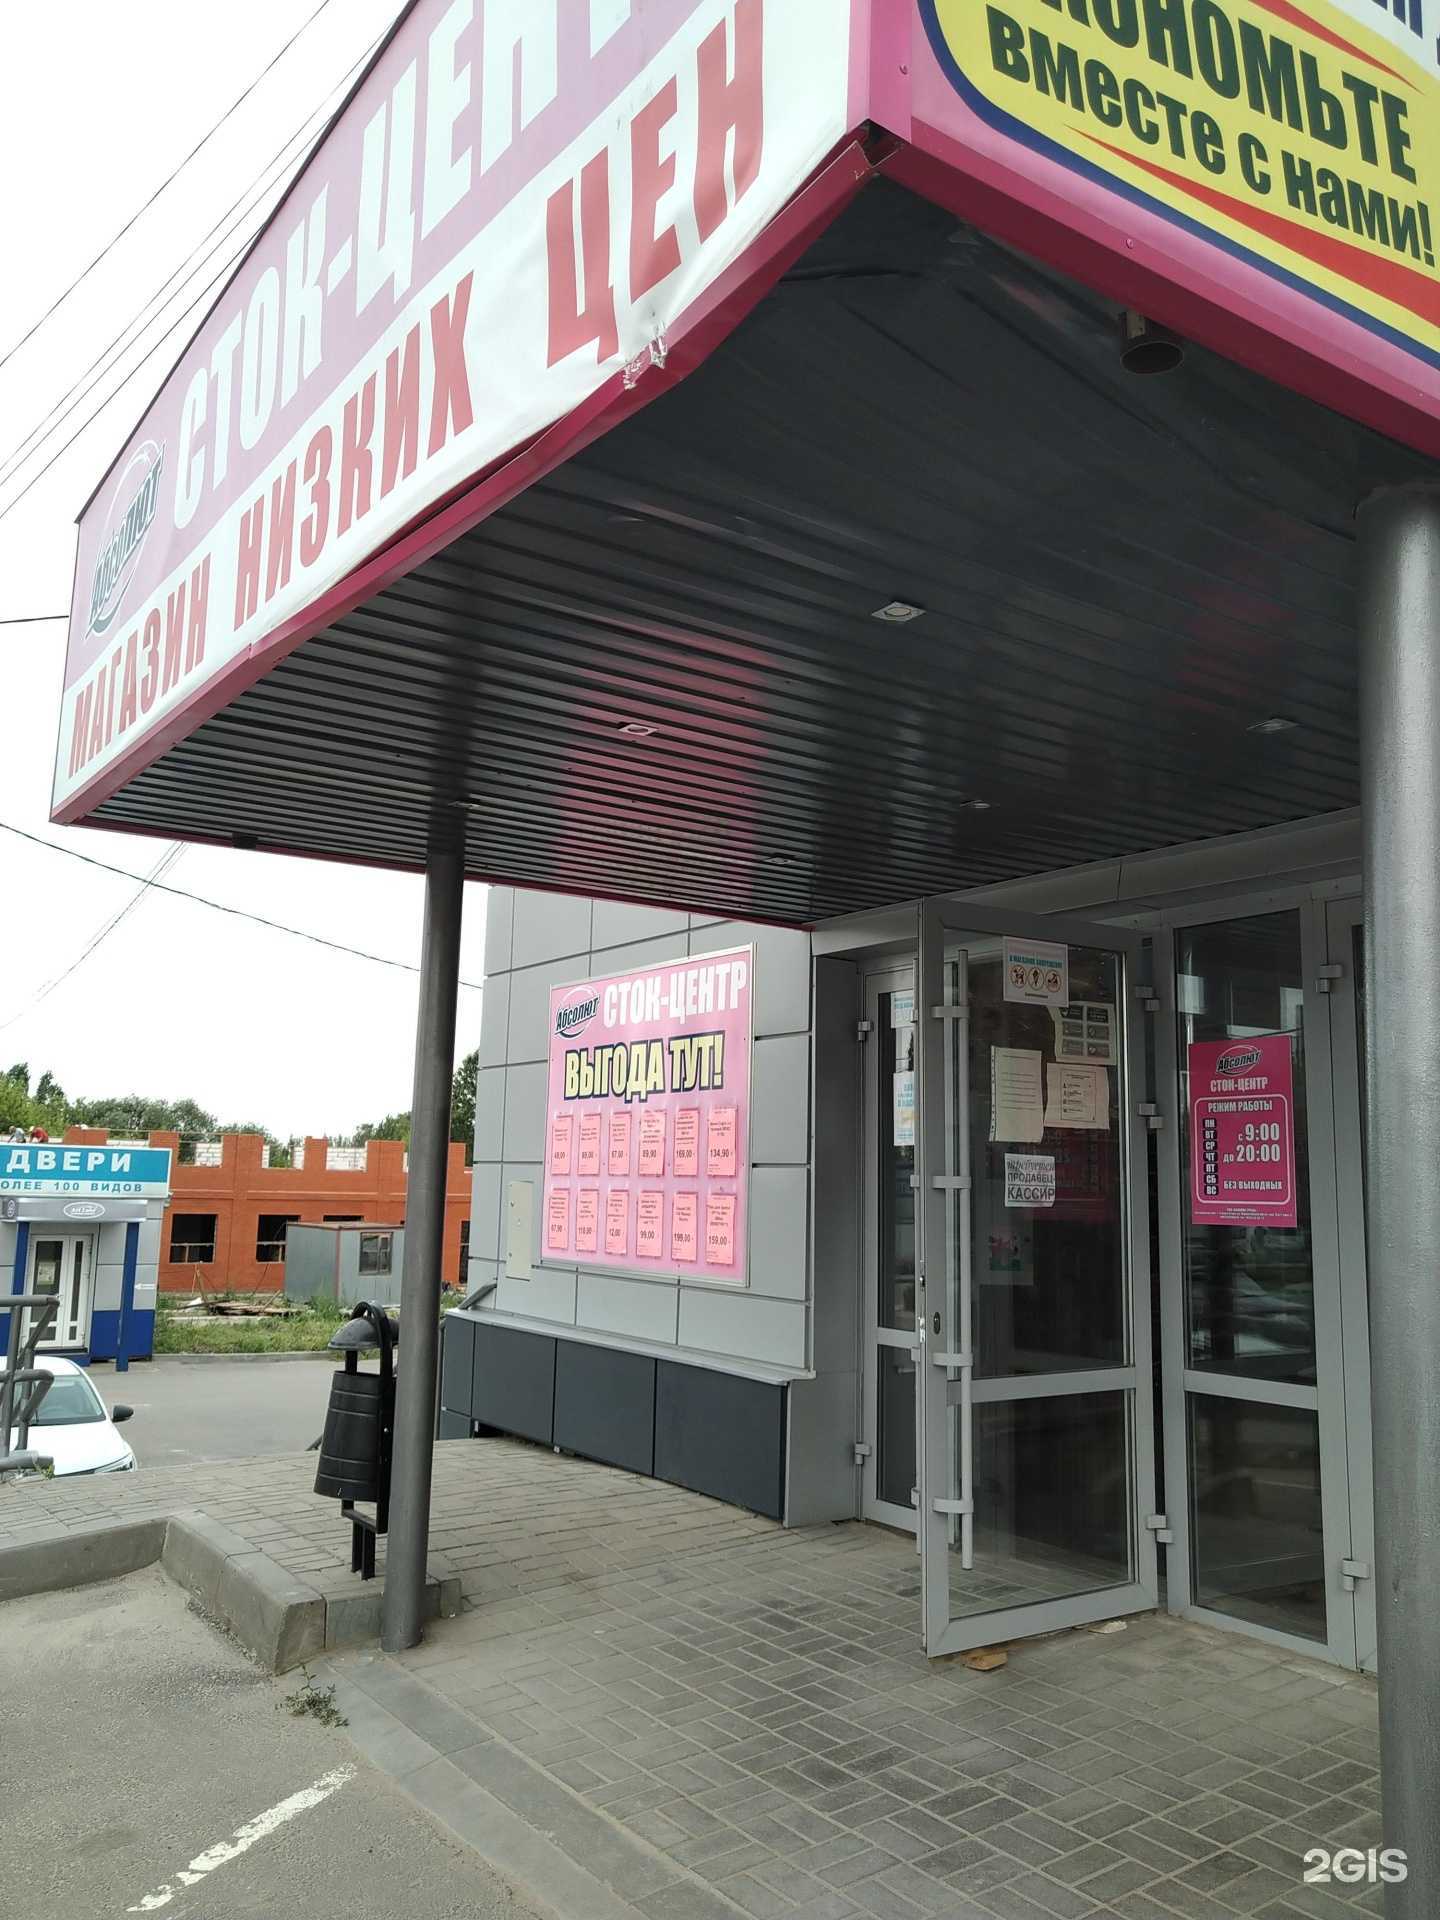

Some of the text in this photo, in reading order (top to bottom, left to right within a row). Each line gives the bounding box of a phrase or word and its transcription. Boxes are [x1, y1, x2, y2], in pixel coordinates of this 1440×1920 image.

[1041, 0, 1417, 184] ОНОМЬТЕ
[986, 4, 1435, 268] вместе с нами!
[173, 0, 631, 529] СТОК-ЦЕН
[68, 0, 763, 780] МАГАЗИН НИЗКИХ ЦЕН
[603, 960, 747, 1028] СТОК-ЦЕНТР
[564, 1030, 726, 1104] ВЫГОДА ТУТ!
[1210, 1077, 1269, 1092] СТОК-ЦЕНТР
[1208, 1100, 1272, 1113] РЕЖИМ РАБОТЫ
[1204, 1119, 1215, 1128] ПН
[1205, 1130, 1215, 1139] ВТ
[1245, 1123, 1280, 1141] 9:00
[1205, 1141, 1215, 1150] СР
[1206, 1152, 1215, 1161] ЧТ
[1223, 1144, 1280, 1163] до 20:00
[6, 1150, 131, 1173] ДВЕРИ
[1206, 1163, 1215, 1172] ПТ
[1206, 1174, 1216, 1184] СБ
[1, 1181, 142, 1193] ОЛЕЕ 100 ВИДОВ
[1008, 1186, 1056, 1200] КАССИР
[1206, 1185, 1217, 1195] ВС
